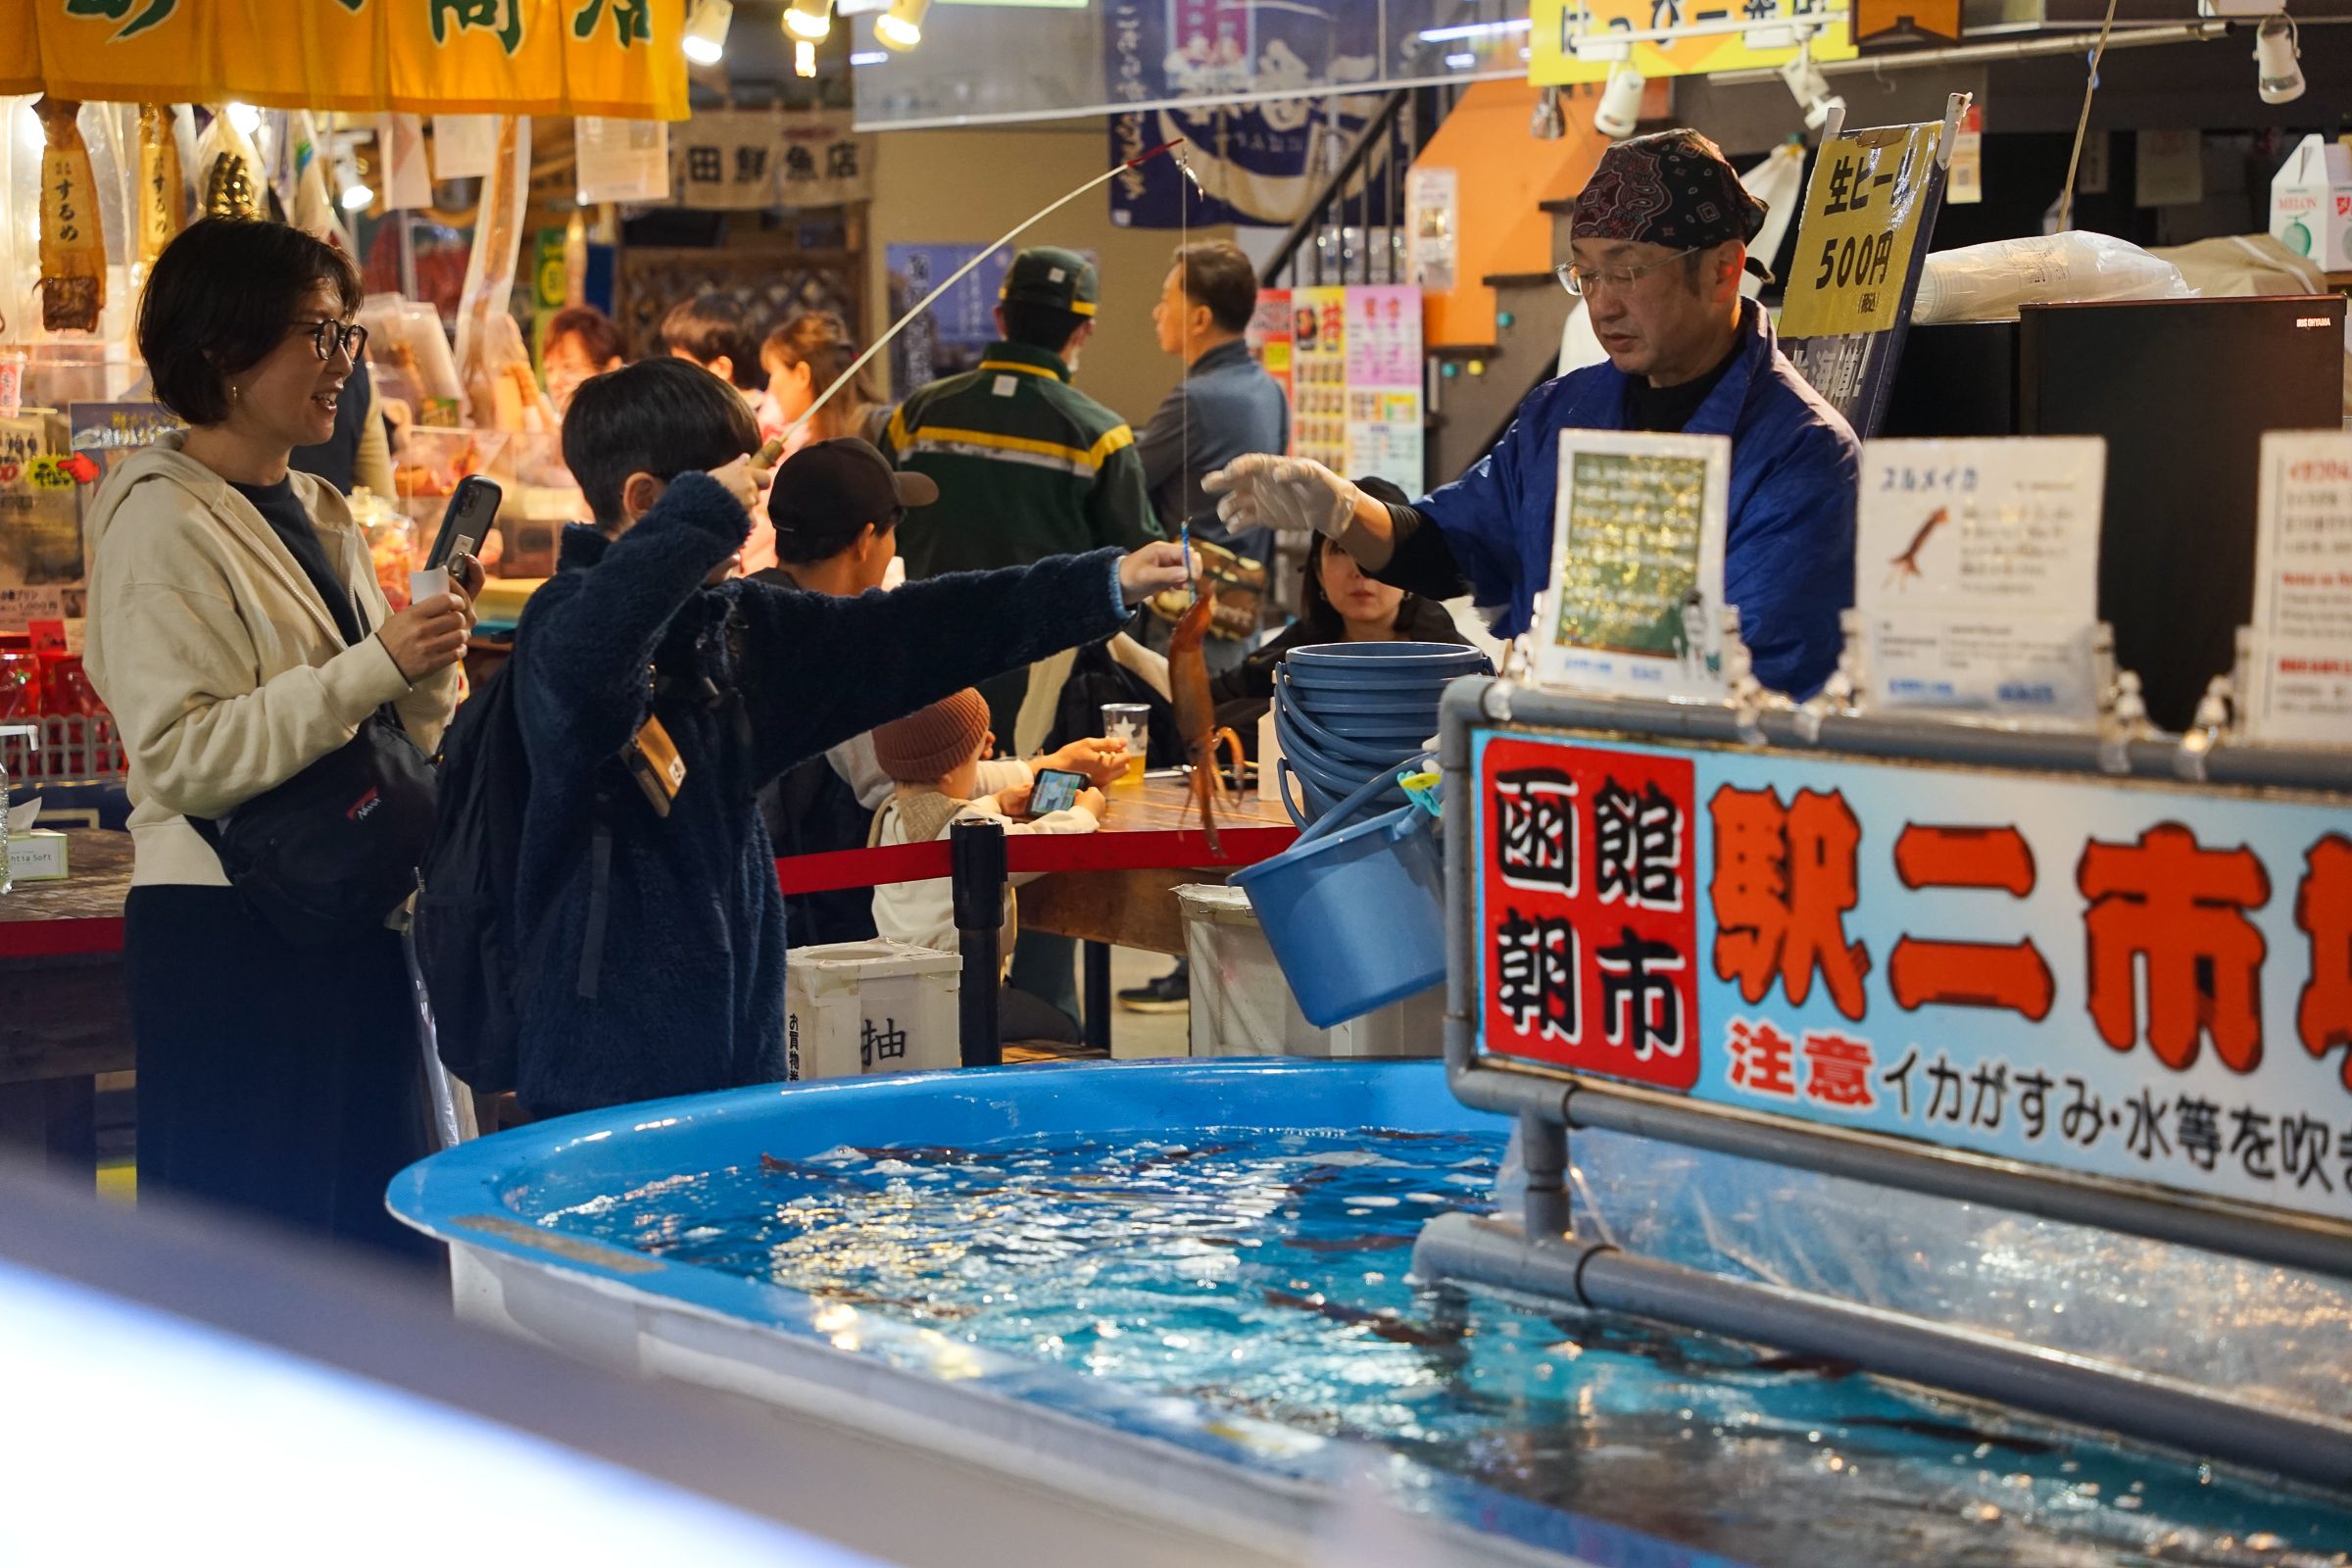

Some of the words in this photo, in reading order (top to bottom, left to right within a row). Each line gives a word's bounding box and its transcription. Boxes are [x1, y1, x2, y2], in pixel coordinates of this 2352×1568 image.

[55, 178, 79, 242] するめ
[1815, 229, 1894, 291] 500円
[33, 853, 54, 862] Soft
[1495, 767, 1684, 912] 函館
[1496, 906, 1686, 1061] 朝市
[860, 1017, 906, 1067] 抽
[1728, 1020, 1875, 1108] 注意
[1883, 1049, 2352, 1193] イカがすみ・水等を吹
